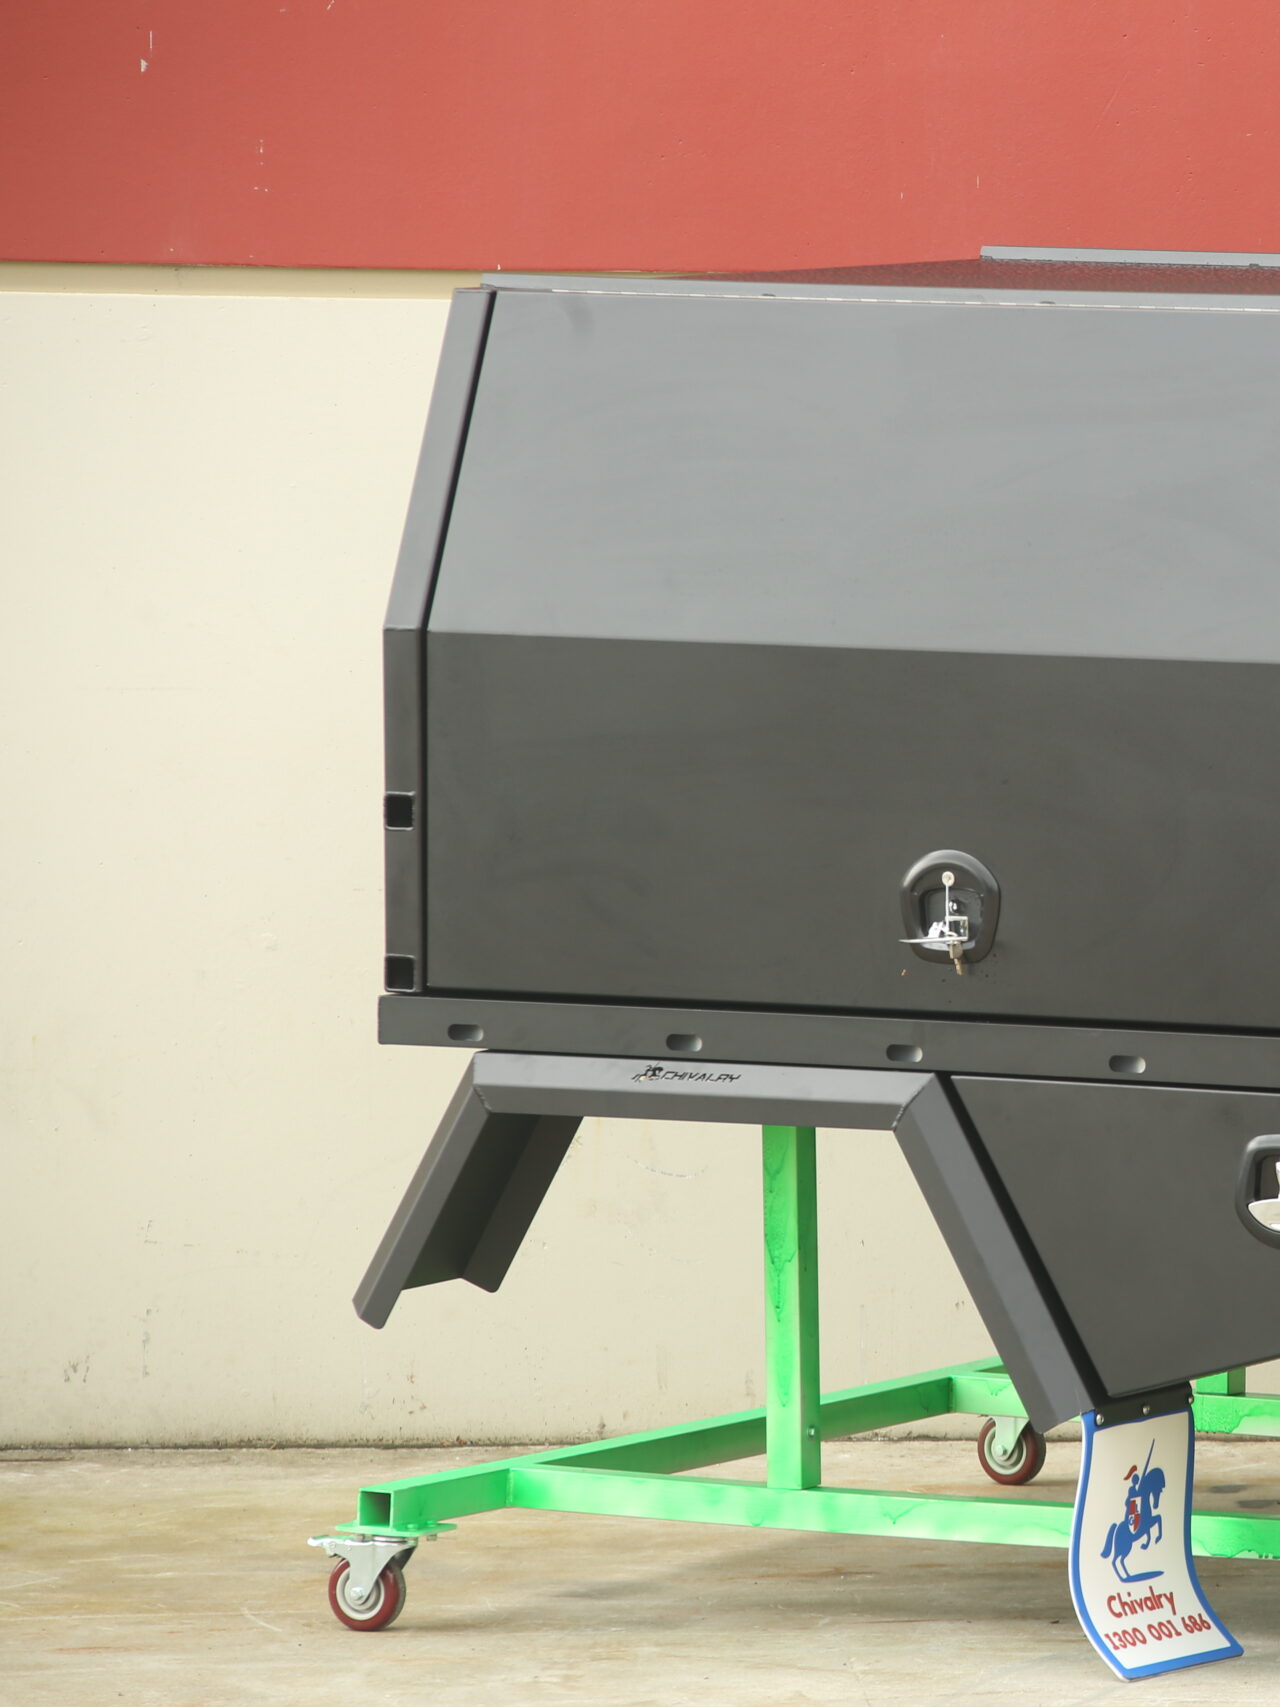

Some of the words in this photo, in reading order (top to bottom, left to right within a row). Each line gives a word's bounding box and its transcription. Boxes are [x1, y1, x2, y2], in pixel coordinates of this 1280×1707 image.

[1107, 1586, 1177, 1618] Chivalry
[1105, 1627, 1147, 1650] 1300
[1147, 1620, 1182, 1641] 001
[1181, 1613, 1212, 1634] 686
